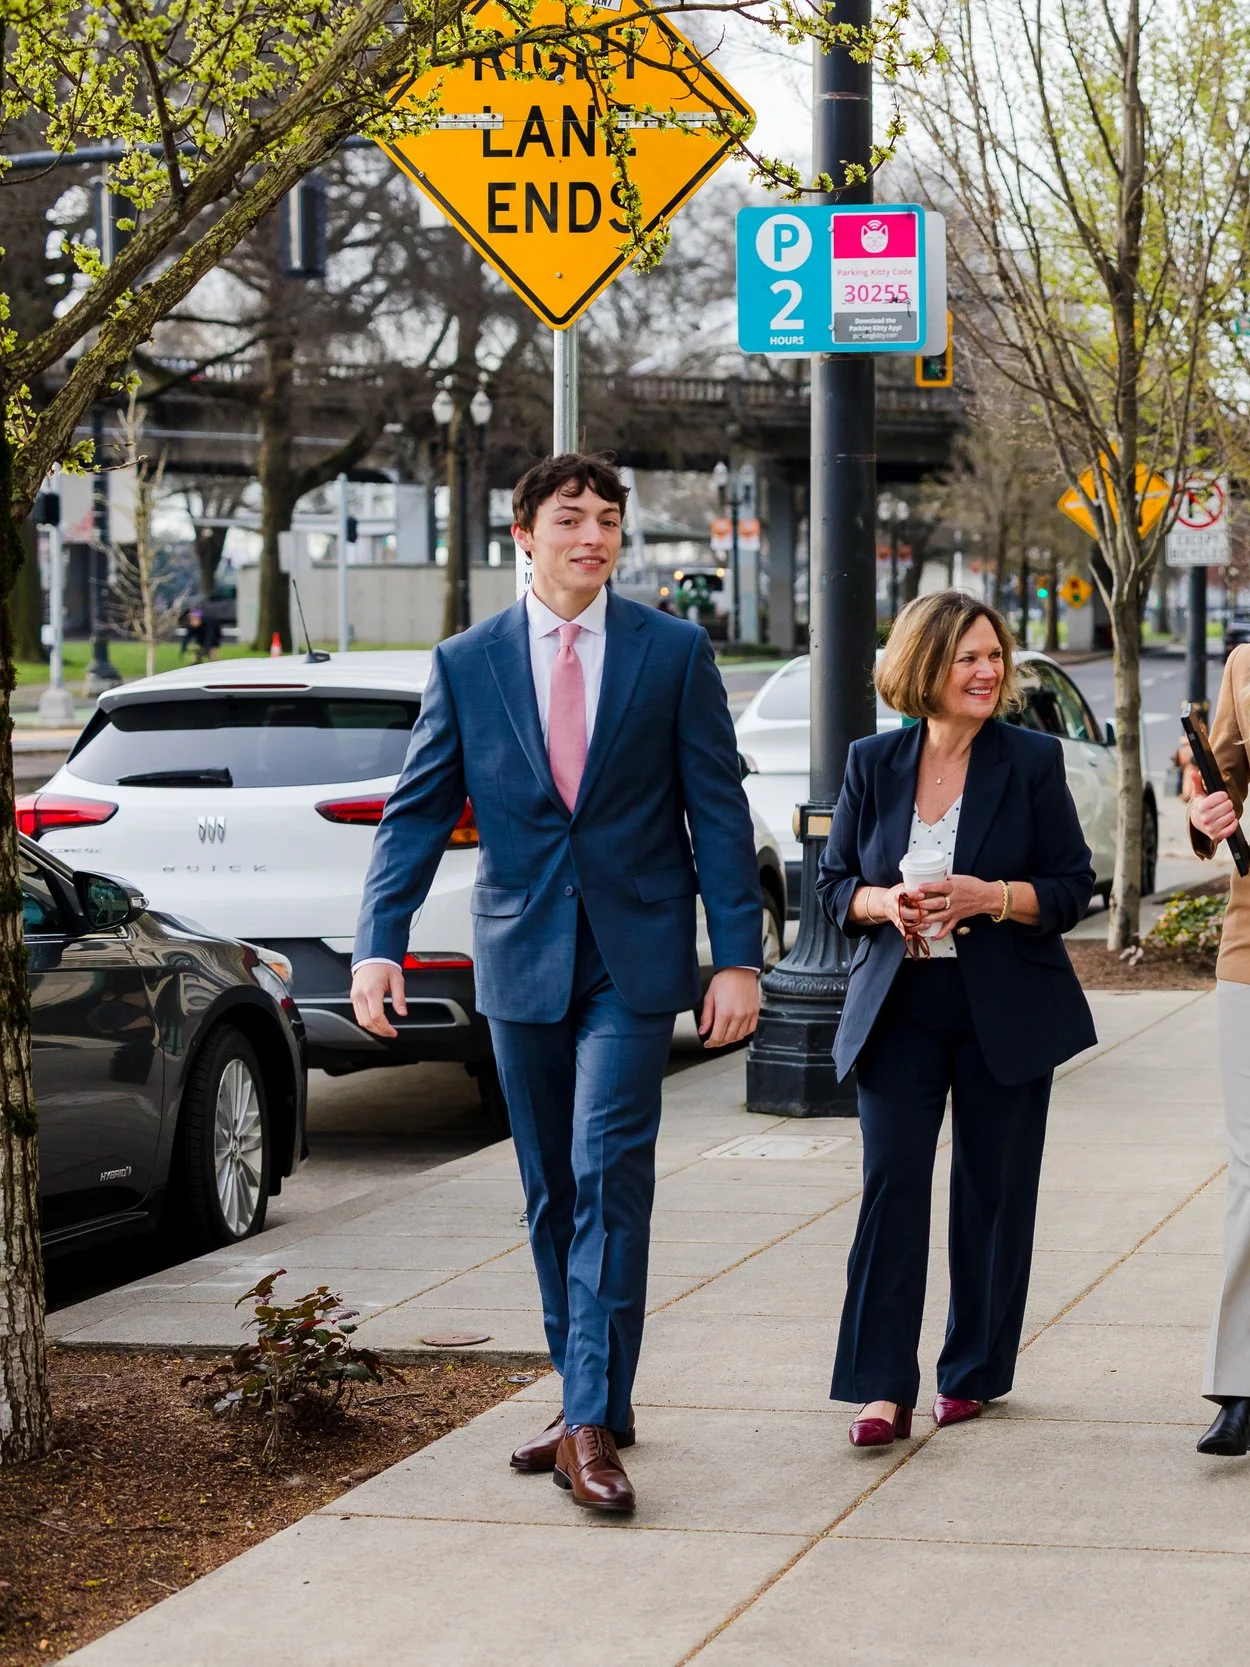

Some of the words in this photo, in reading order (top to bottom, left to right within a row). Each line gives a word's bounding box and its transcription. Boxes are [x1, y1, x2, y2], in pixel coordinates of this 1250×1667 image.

[773, 223, 800, 262] P
[837, 268, 868, 278] Parking
[871, 267, 890, 277] Kitty
[893, 267, 912, 276] Code
[844, 284, 909, 303] 30255
[769, 279, 804, 330] 2
[769, 336, 804, 345] HOURS
[162, 864, 268, 873] BUICK
[100, 1167, 127, 1182] HYBRID
